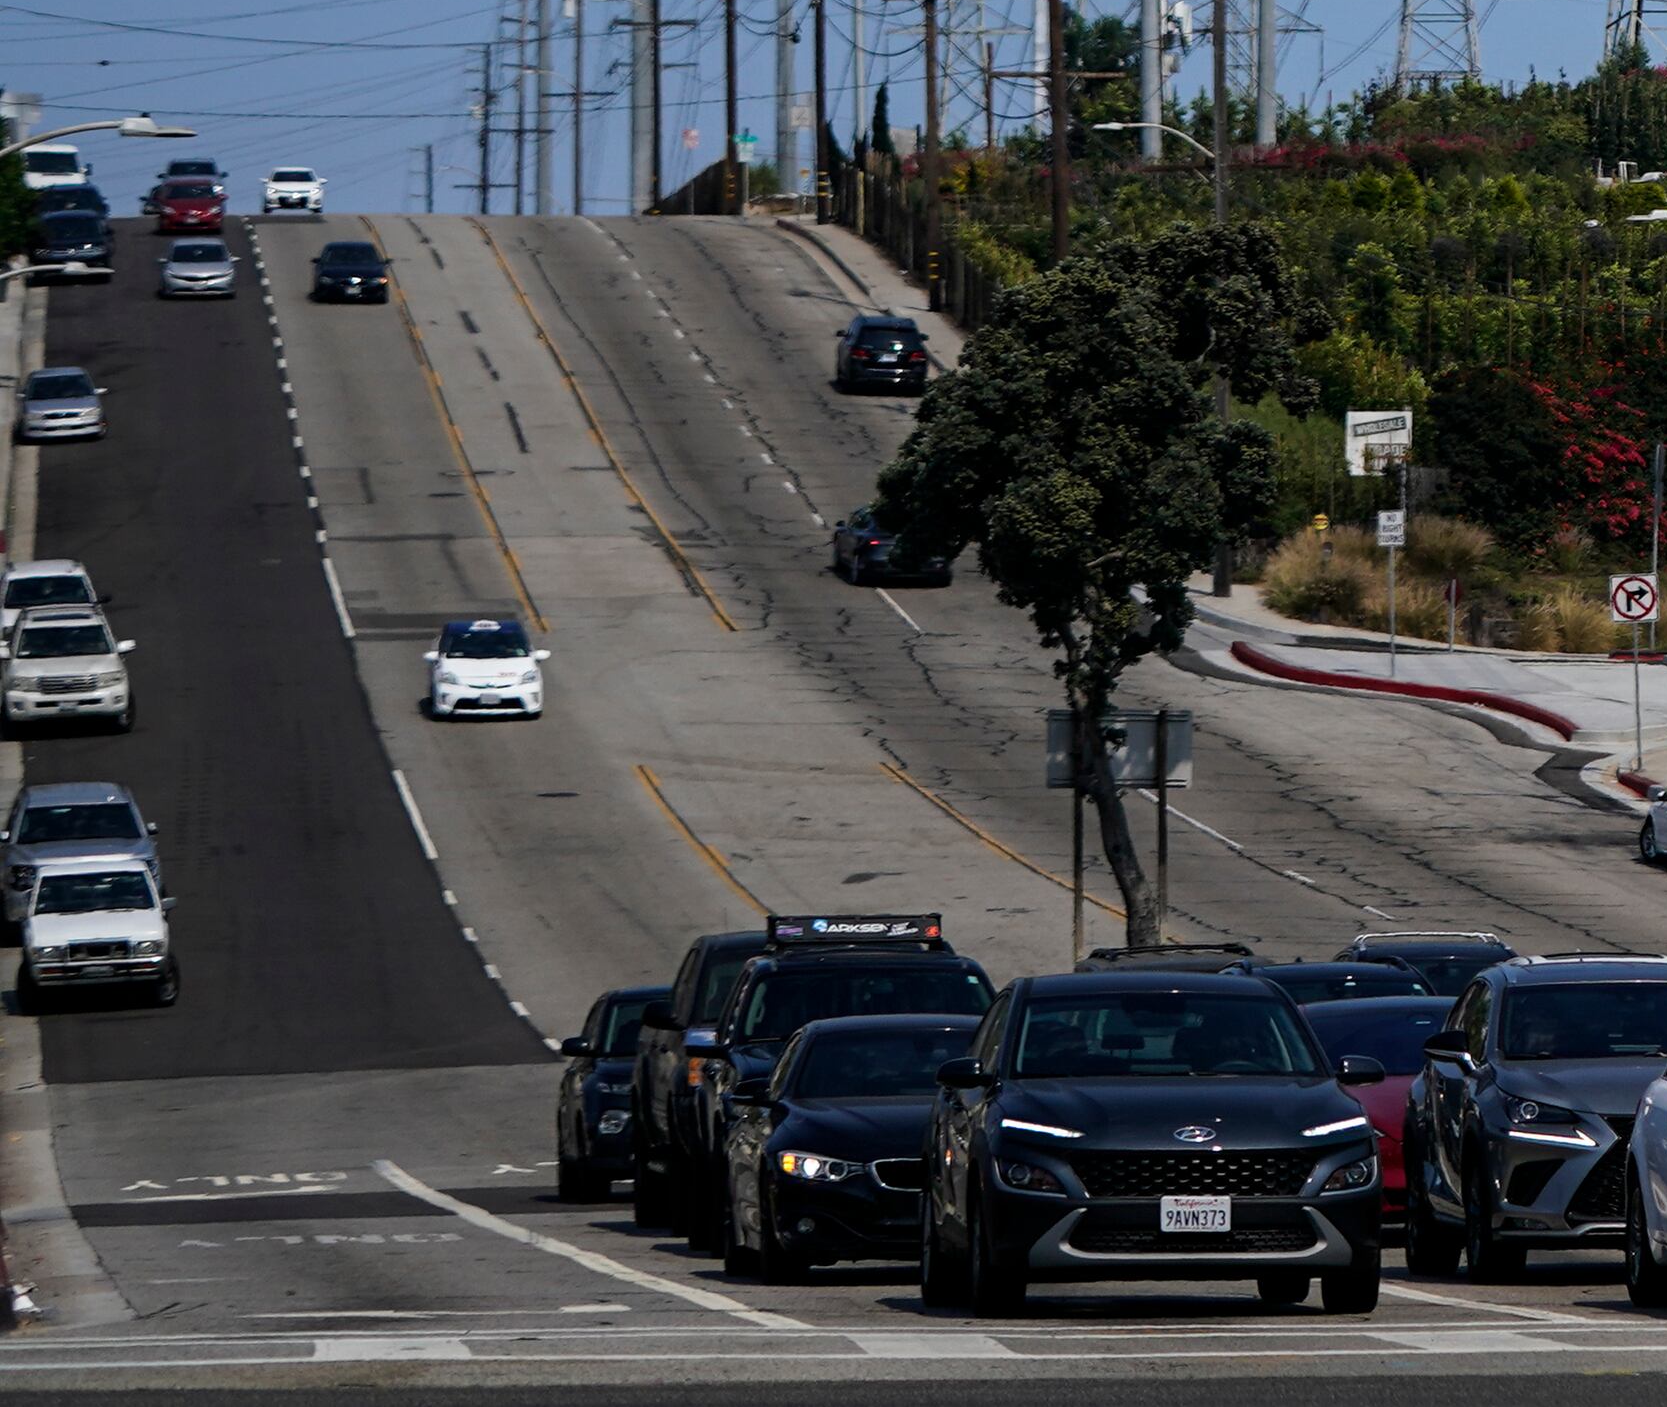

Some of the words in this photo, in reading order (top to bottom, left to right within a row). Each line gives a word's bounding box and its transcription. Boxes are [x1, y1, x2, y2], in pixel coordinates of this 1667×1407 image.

[1355, 418, 1406, 435] WHOLESALE
[1386, 513, 1398, 523] NO
[1382, 523, 1404, 533] RIGHT
[120, 1170, 349, 1192] ONLY
[1166, 1209, 1227, 1227] 9AVN373
[177, 1232, 465, 1249] ONLY
